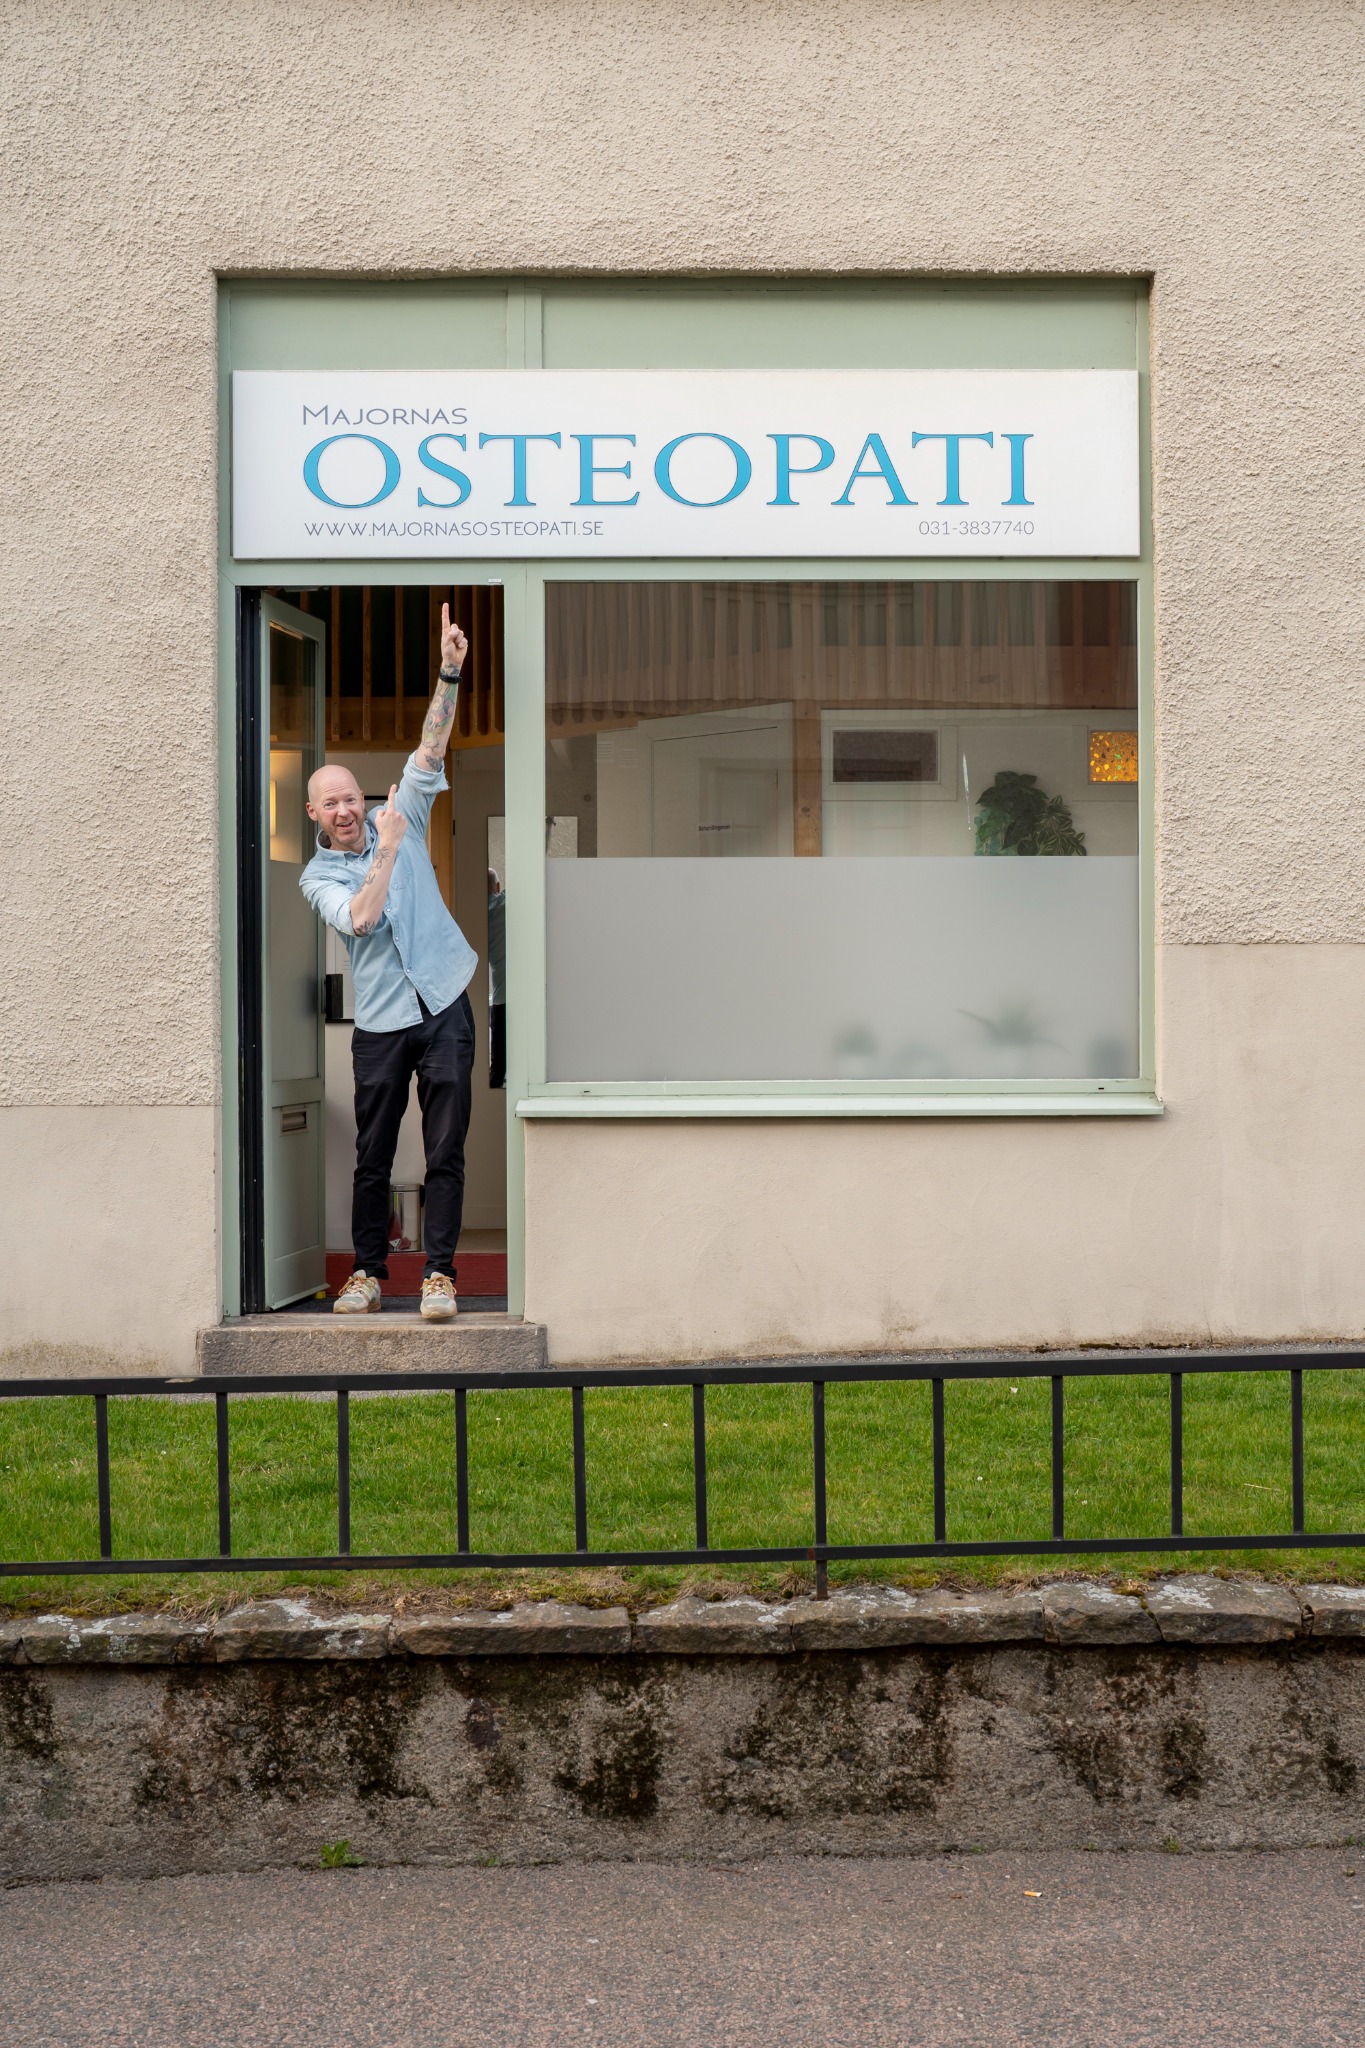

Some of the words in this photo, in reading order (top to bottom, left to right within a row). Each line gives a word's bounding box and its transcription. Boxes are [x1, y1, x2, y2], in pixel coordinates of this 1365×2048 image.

[303, 404, 468, 425] MAJORNAS
[303, 431, 1035, 509] OSTEOPATI
[304, 521, 604, 537] WWW.MAJORNASOSTEOPATI.SE
[918, 520, 1035, 535] 031-3837740
